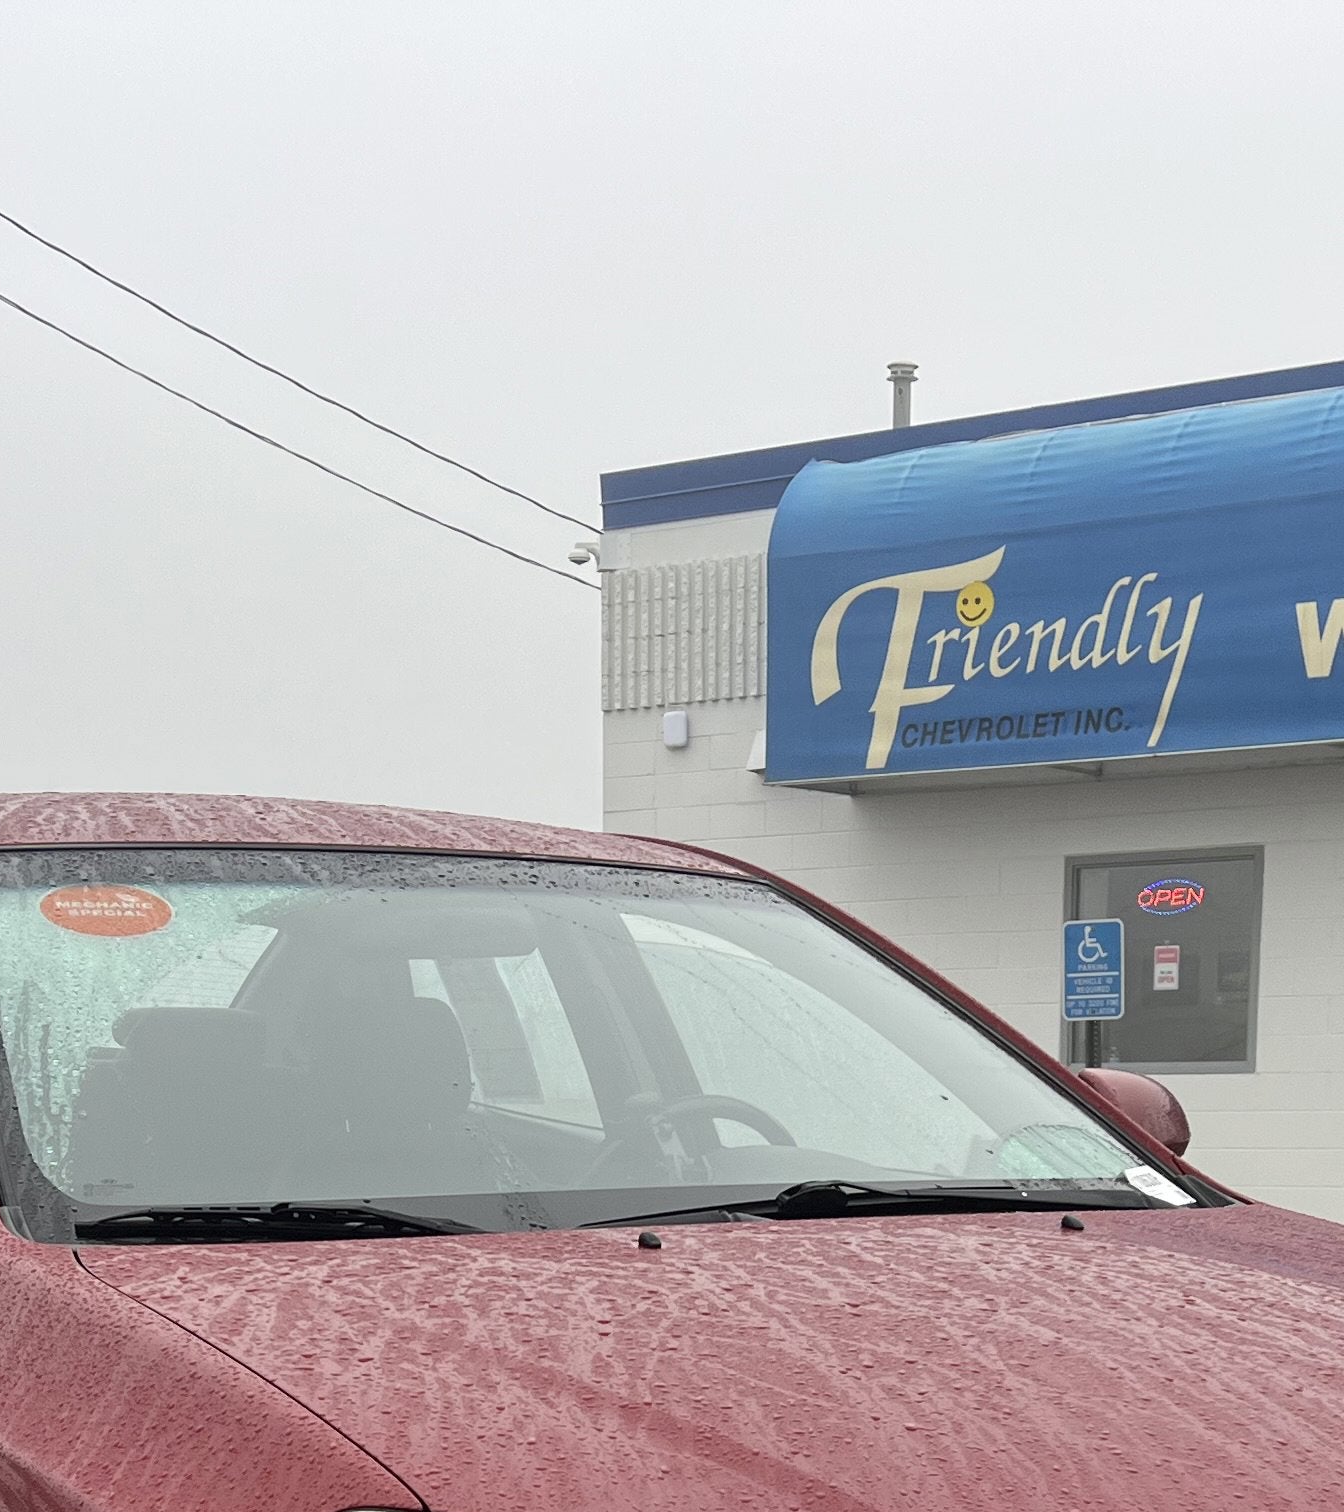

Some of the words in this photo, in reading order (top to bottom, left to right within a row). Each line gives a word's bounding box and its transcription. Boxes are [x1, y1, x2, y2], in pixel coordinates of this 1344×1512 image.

[810, 543, 1204, 770] Friendly
[899, 709, 1067, 751] CHEVROLET
[1072, 705, 1132, 736] INC.
[55, 900, 153, 909] MECHANIC
[1137, 887, 1205, 907] OPEN
[68, 909, 146, 917] SPECIAL
